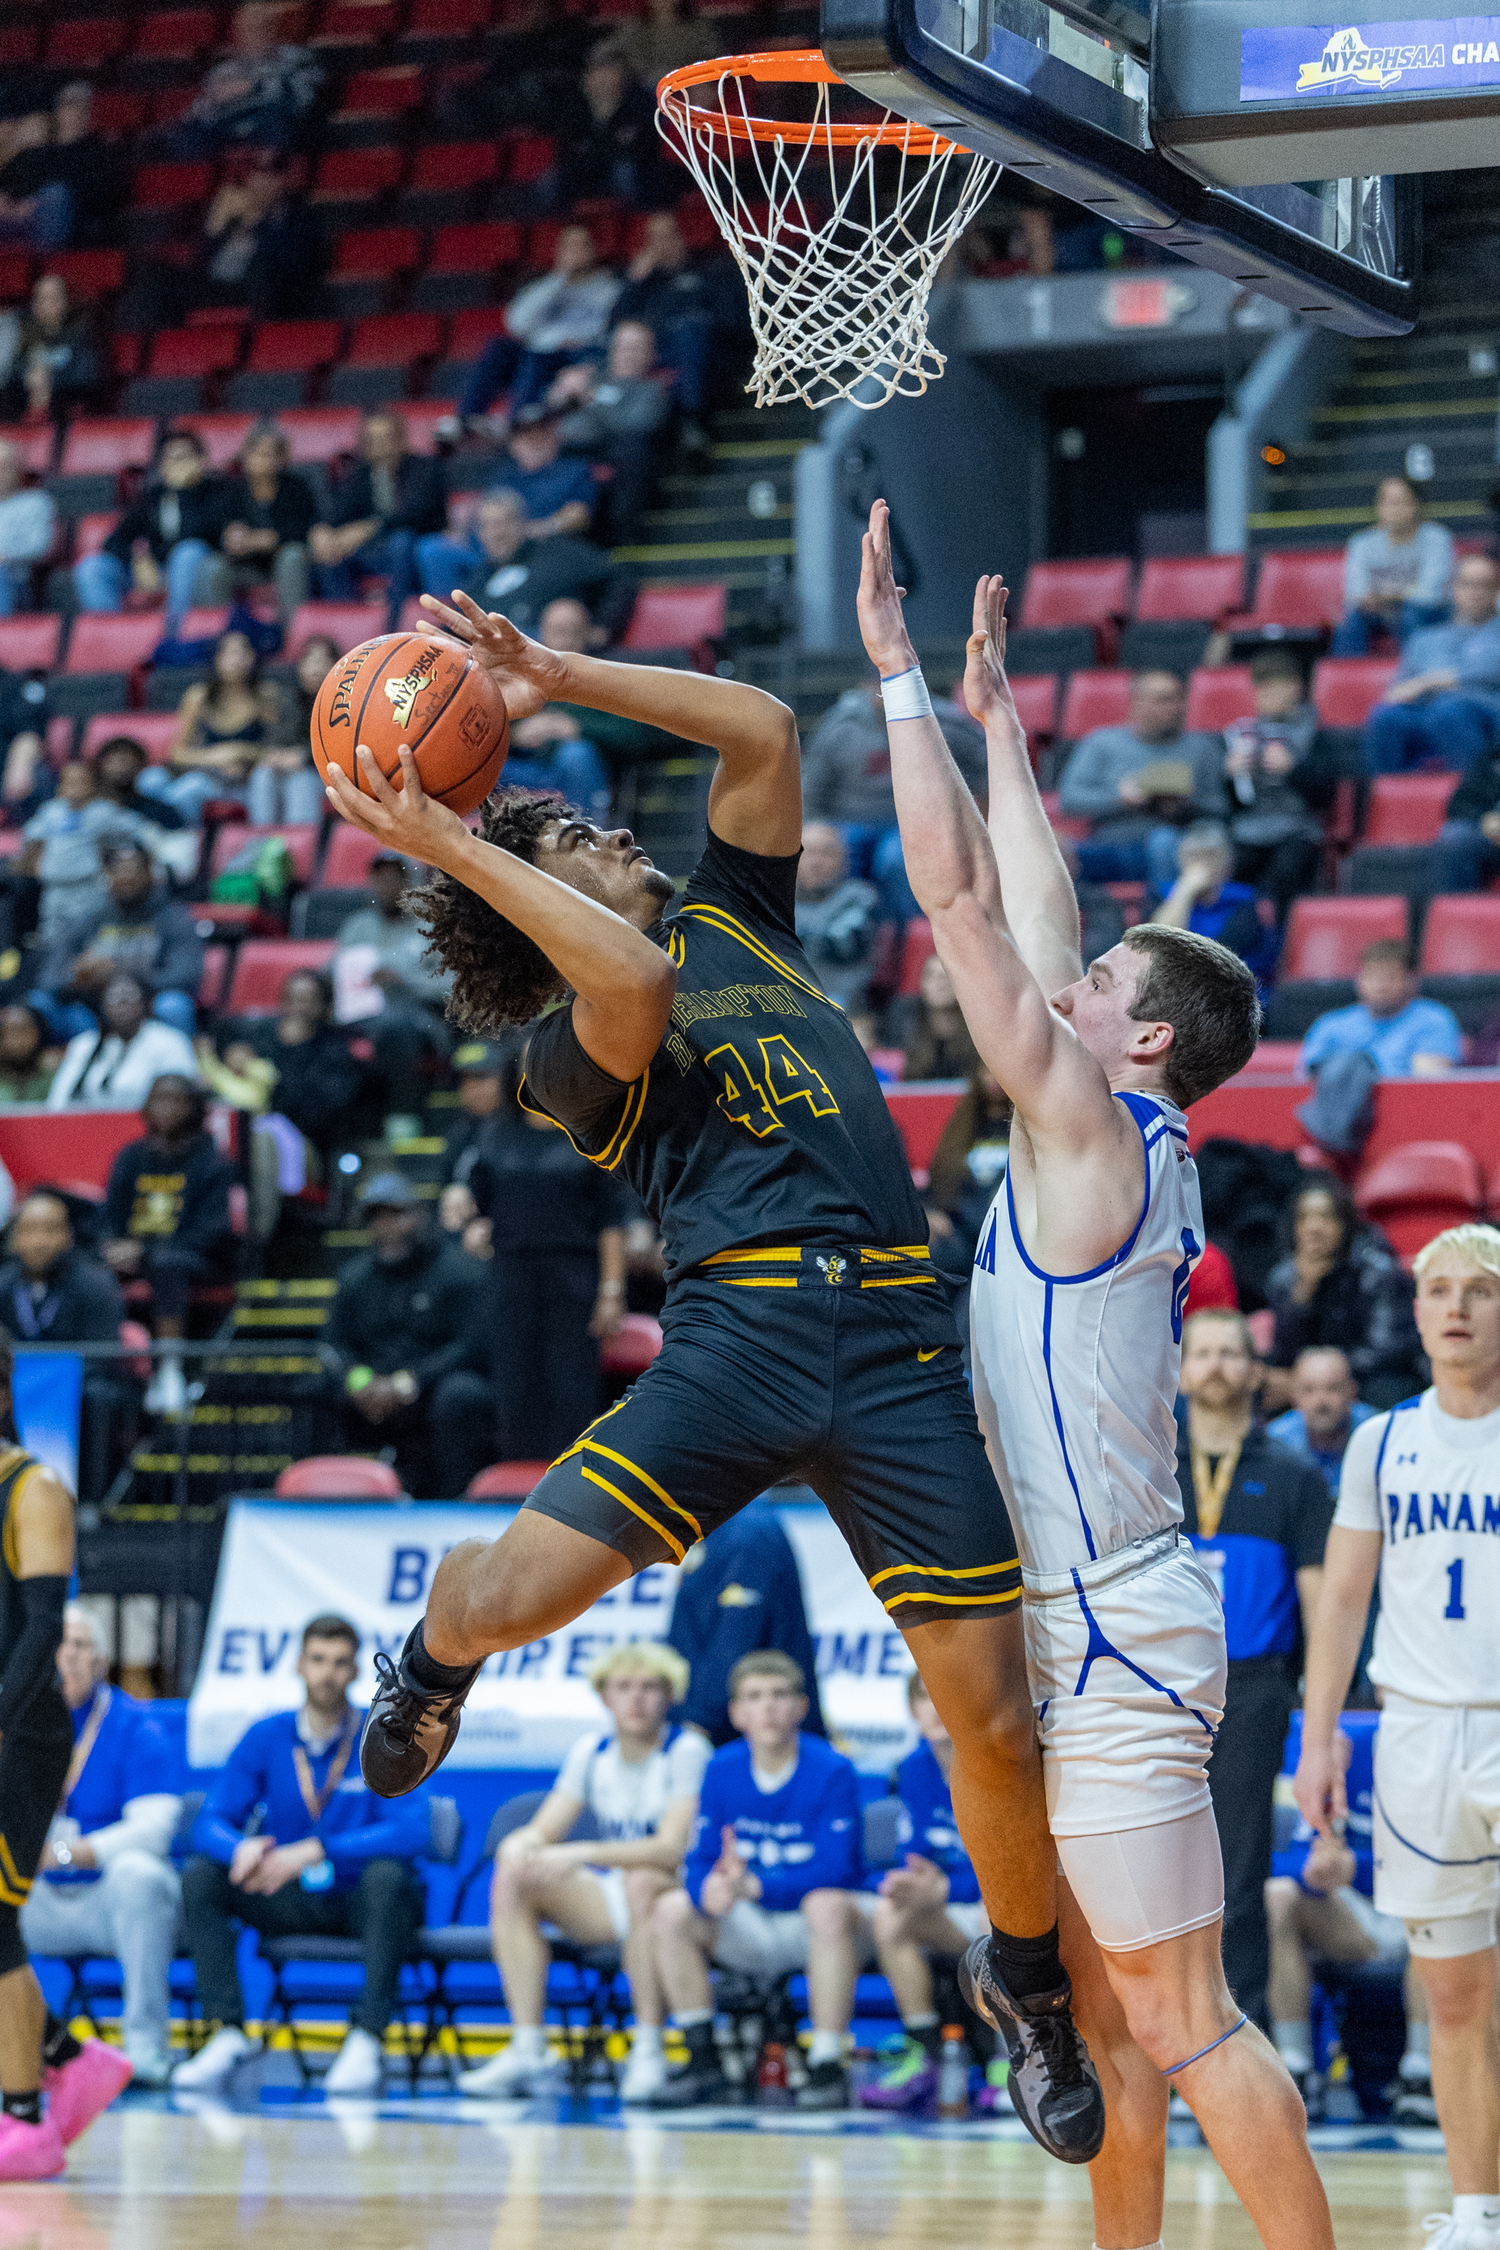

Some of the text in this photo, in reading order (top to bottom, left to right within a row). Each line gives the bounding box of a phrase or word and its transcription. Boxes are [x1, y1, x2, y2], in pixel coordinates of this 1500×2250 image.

[1320, 41, 1500, 73] NYSPHSAA CHA
[392, 645, 445, 710] NYSPHSAA
[703, 1033, 841, 1138] 44
[1444, 1558, 1466, 1620] 1
